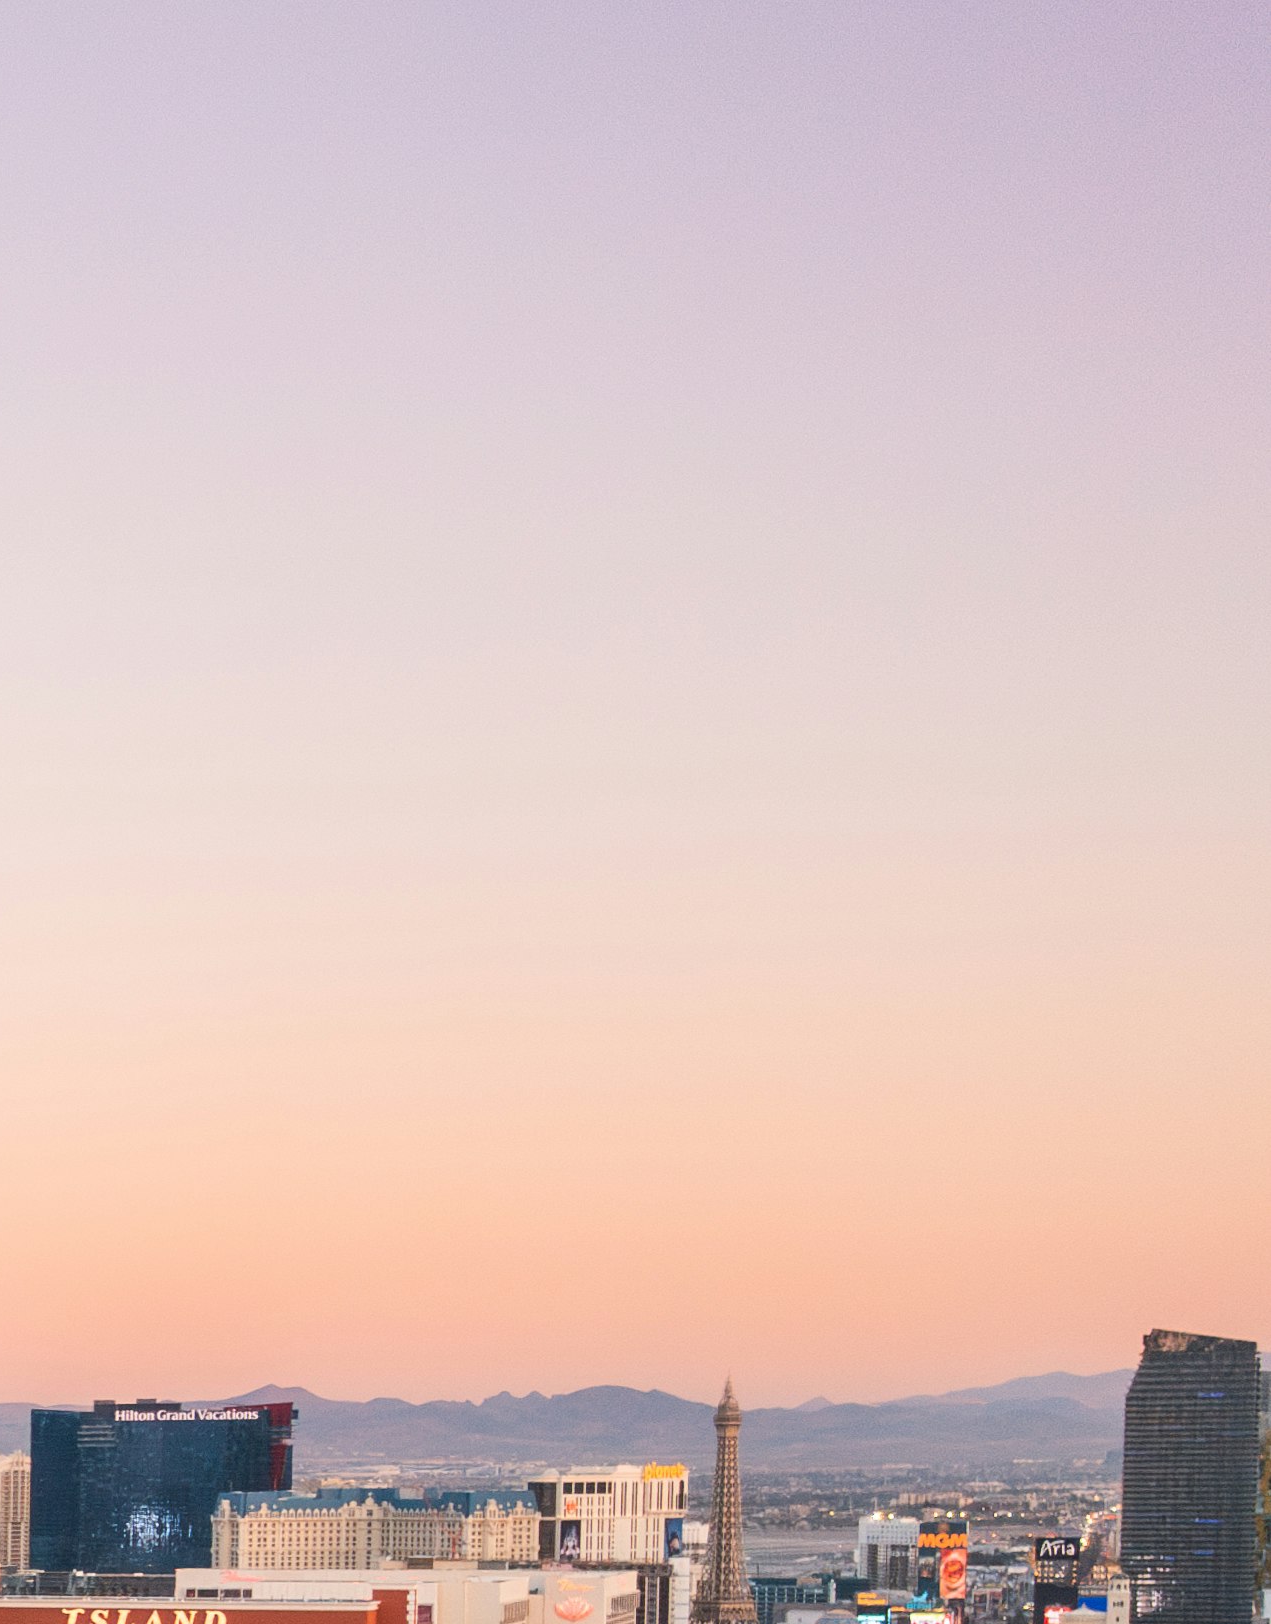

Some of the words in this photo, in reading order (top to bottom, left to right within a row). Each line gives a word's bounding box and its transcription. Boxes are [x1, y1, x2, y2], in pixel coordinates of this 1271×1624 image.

[115, 1409, 155, 1421] Hilton
[156, 1409, 195, 1421] Grand
[197, 1408, 258, 1420] Vacations
[918, 1533, 967, 1548] MGM
[1040, 1540, 1075, 1556] Aria
